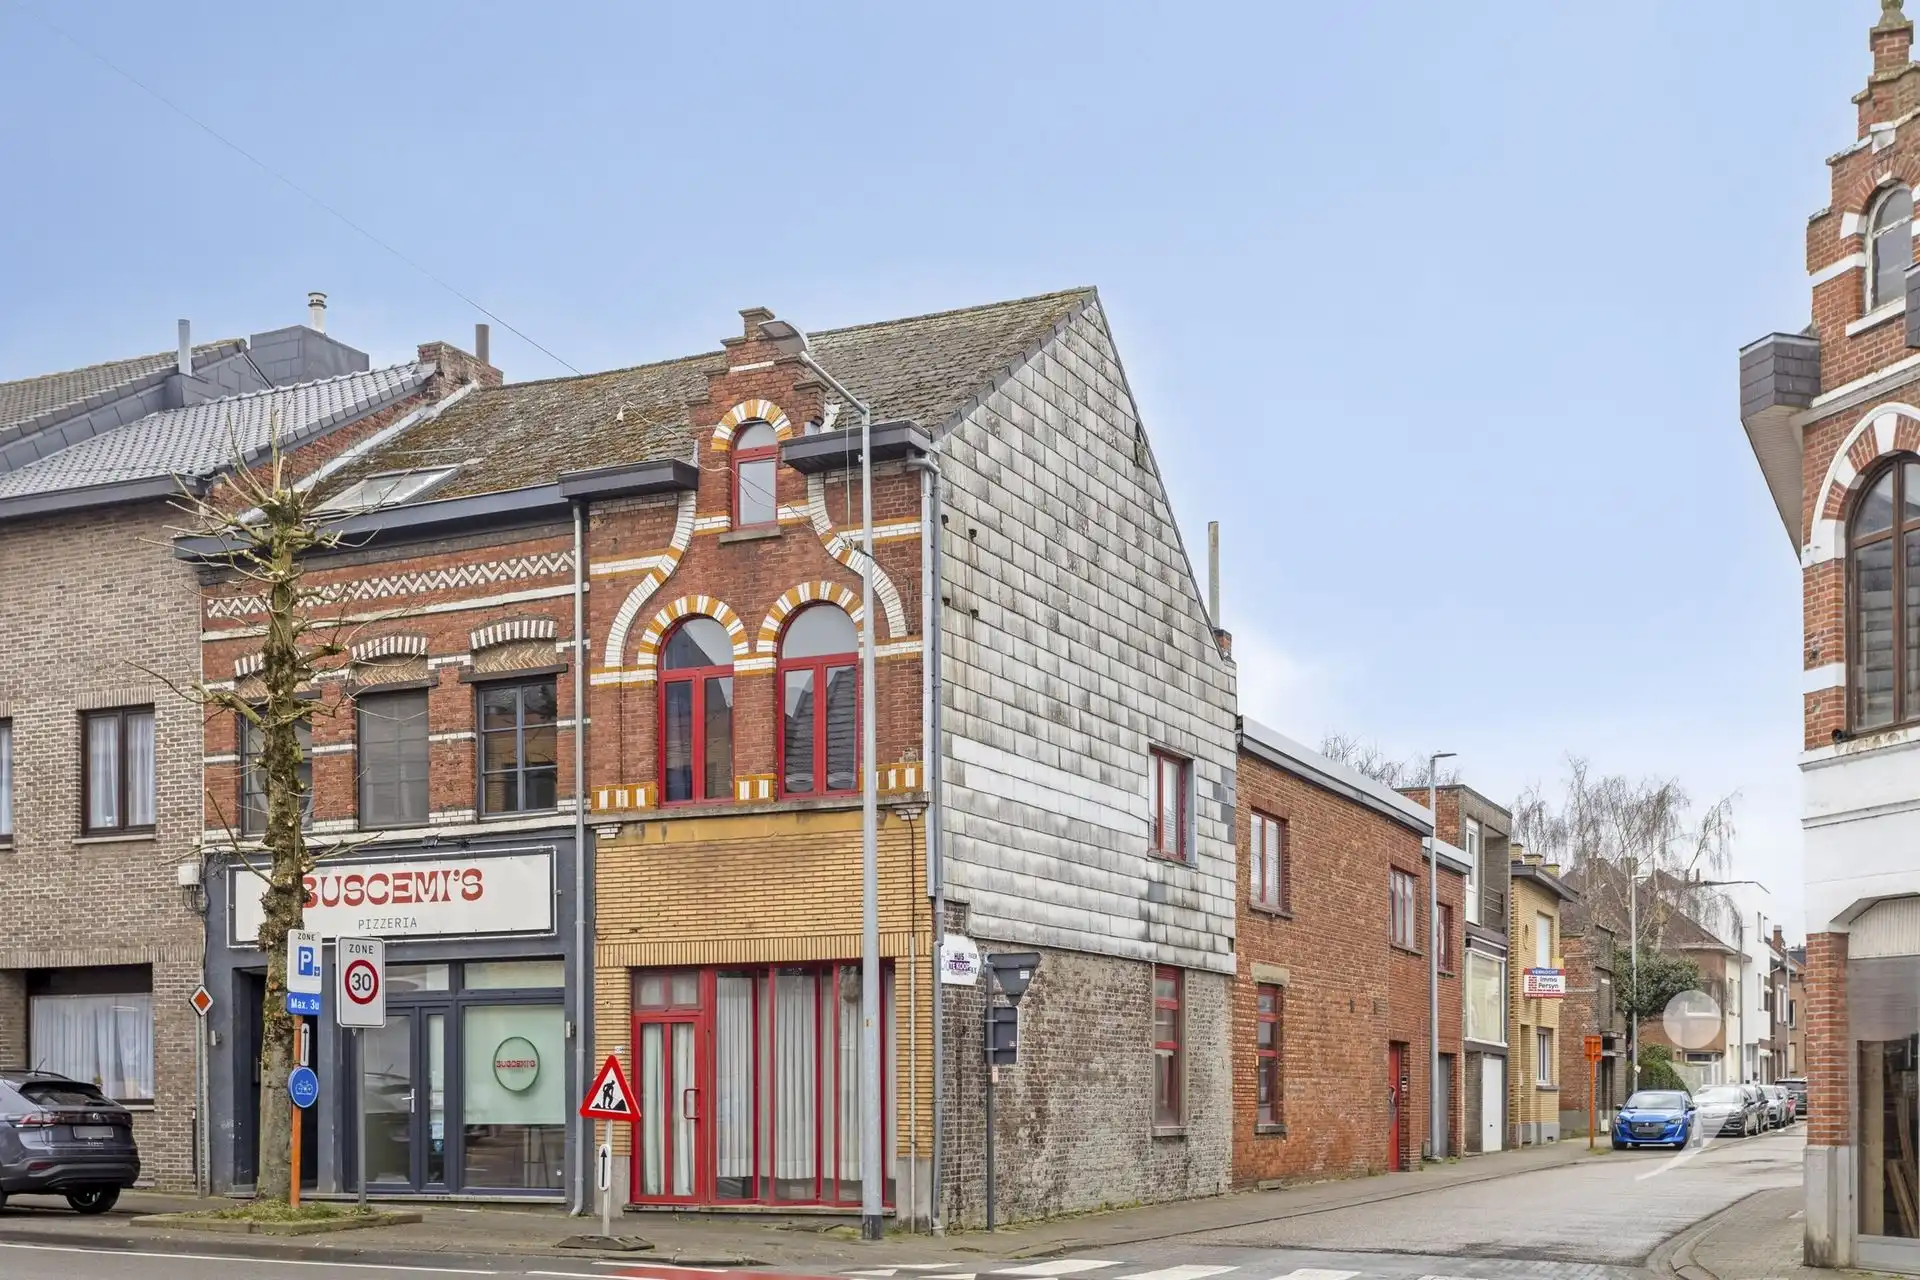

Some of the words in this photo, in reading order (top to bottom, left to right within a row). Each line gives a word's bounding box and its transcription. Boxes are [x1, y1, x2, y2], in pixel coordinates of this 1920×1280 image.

[303, 868, 484, 908] BUSCEMI'S
[358, 917, 418, 930] PIZZERIA
[297, 932, 315, 941] ZONE
[349, 943, 375, 954] ZONE
[300, 951, 312, 971] P
[954, 952, 965, 960] HUIS
[351, 972, 372, 992] 30
[290, 998, 308, 1010] Max.
[309, 999, 320, 1010] 3u
